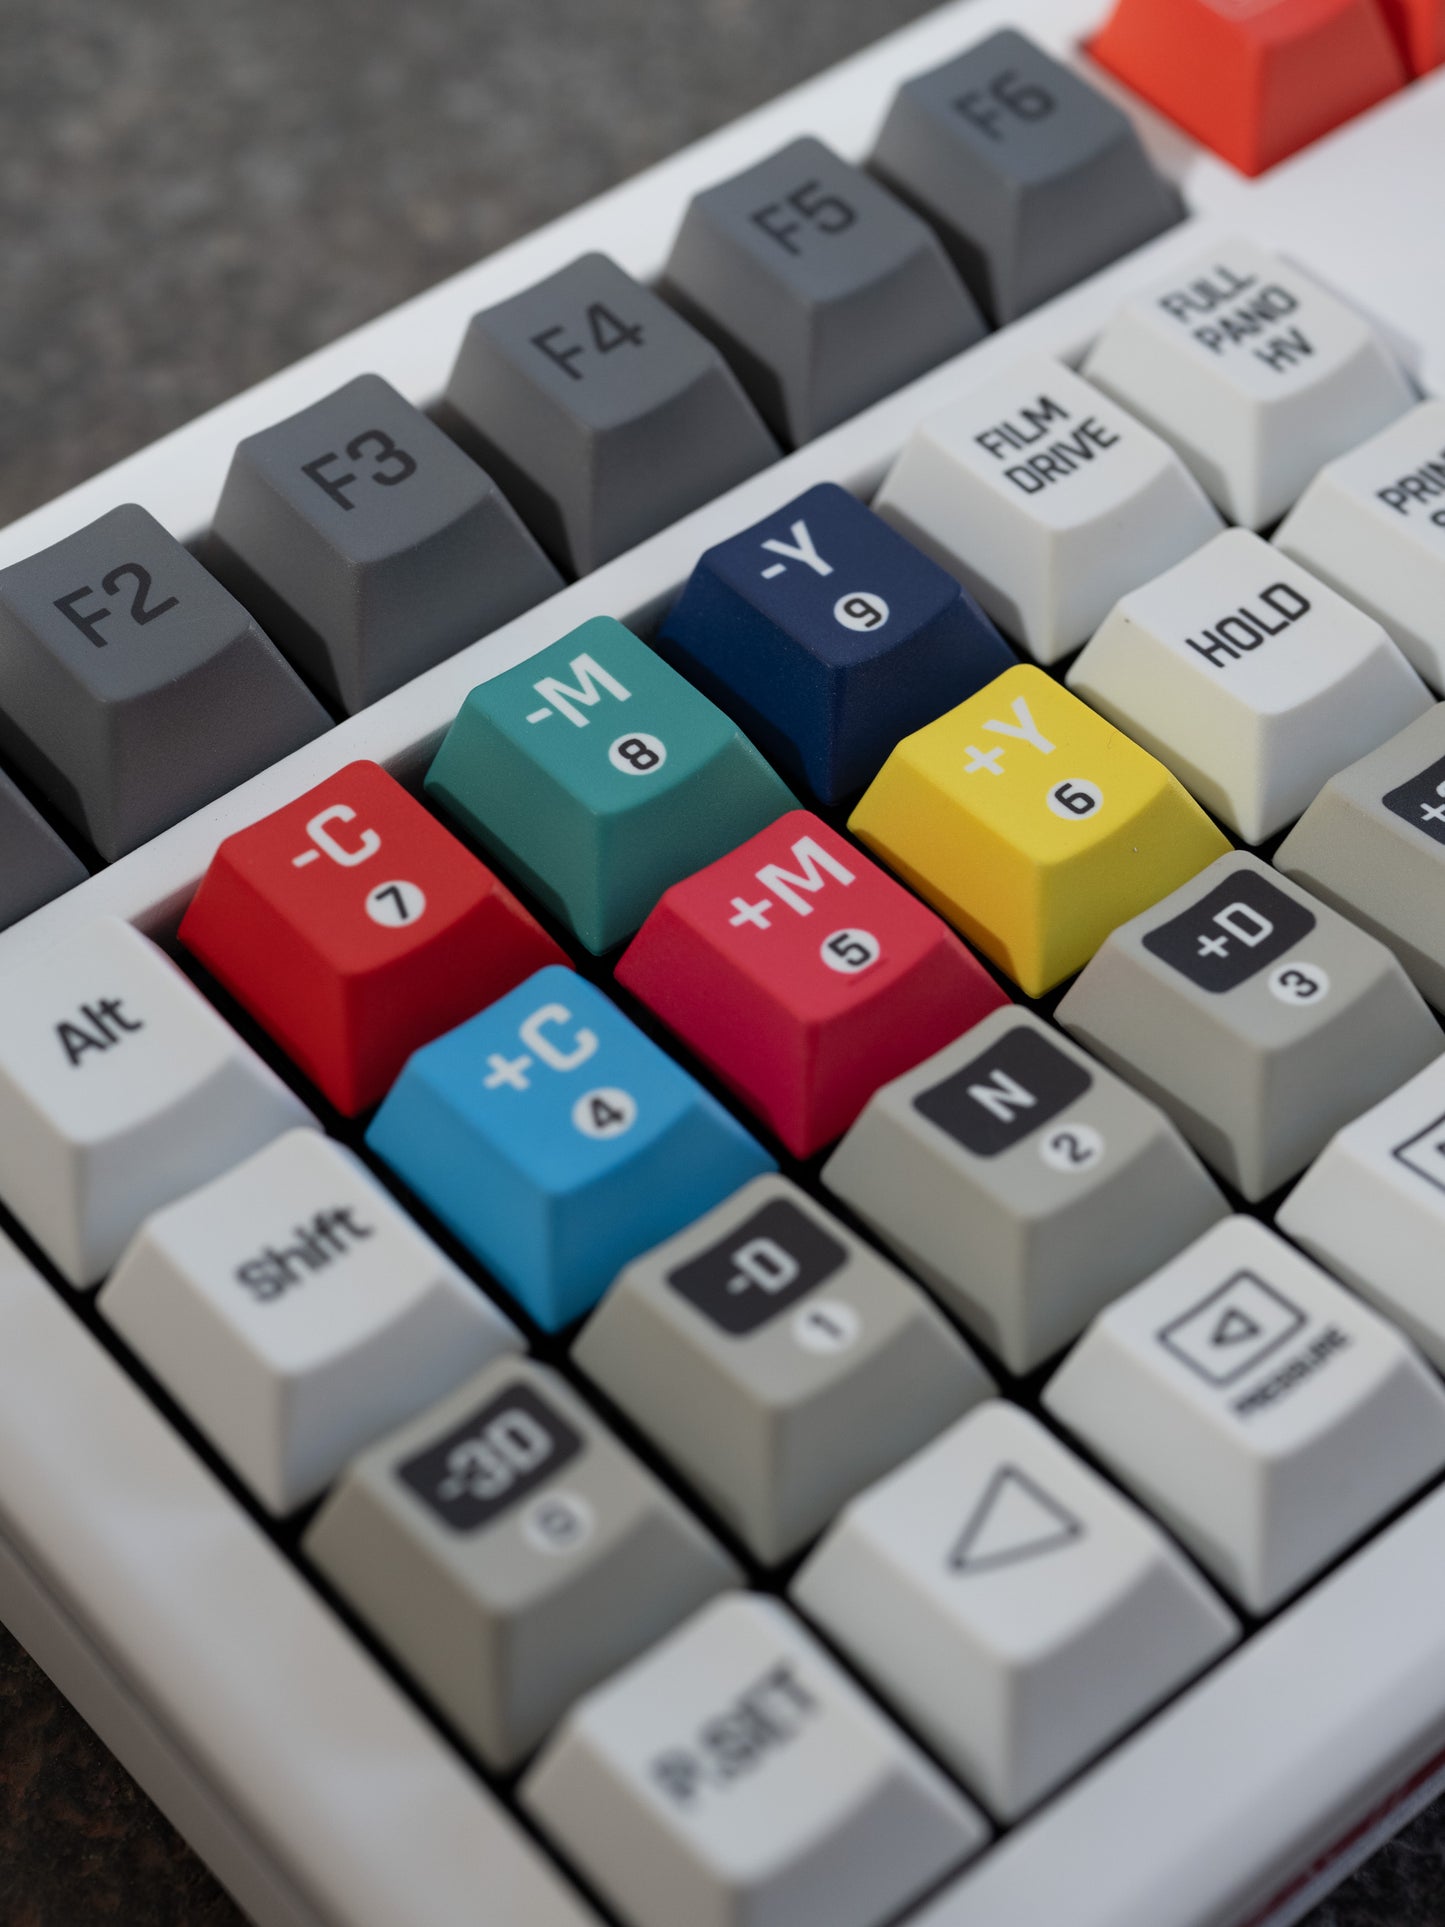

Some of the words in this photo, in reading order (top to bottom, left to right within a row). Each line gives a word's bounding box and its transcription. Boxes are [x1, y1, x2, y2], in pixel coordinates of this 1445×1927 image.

[950, 68, 1056, 142] F6
[750, 179, 858, 256] F5
[1157, 264, 1257, 324] FULL
[1192, 283, 1300, 357] PANO
[530, 302, 645, 381] F4
[1251, 324, 1315, 374] HV
[974, 394, 1070, 459] FILM
[1005, 416, 1120, 496] DRIVE
[301, 428, 417, 511] F3
[760, 519, 834, 580] -Y
[52, 562, 180, 648] F2
[843, 597, 883, 629] 9
[1185, 582, 1311, 669] HOLD
[526, 652, 632, 728] -M
[618, 737, 660, 771] 8
[963, 695, 1057, 776] +Y
[1054, 783, 1097, 815] 6
[291, 803, 382, 868] -C
[375, 885, 410, 921] 7
[728, 835, 857, 930] +M
[826, 933, 872, 967] 5
[1197, 901, 1274, 960] +D
[1279, 968, 1319, 998] 3
[54, 996, 145, 1067] Alt
[483, 1002, 599, 1091] +C
[590, 1096, 626, 1129] 4
[967, 1069, 1037, 1122] N
[1052, 1132, 1094, 1164] 2
[234, 1204, 376, 1305] Shift
[726, 1237, 800, 1296] -D
[437, 1409, 555, 1500] -3D
